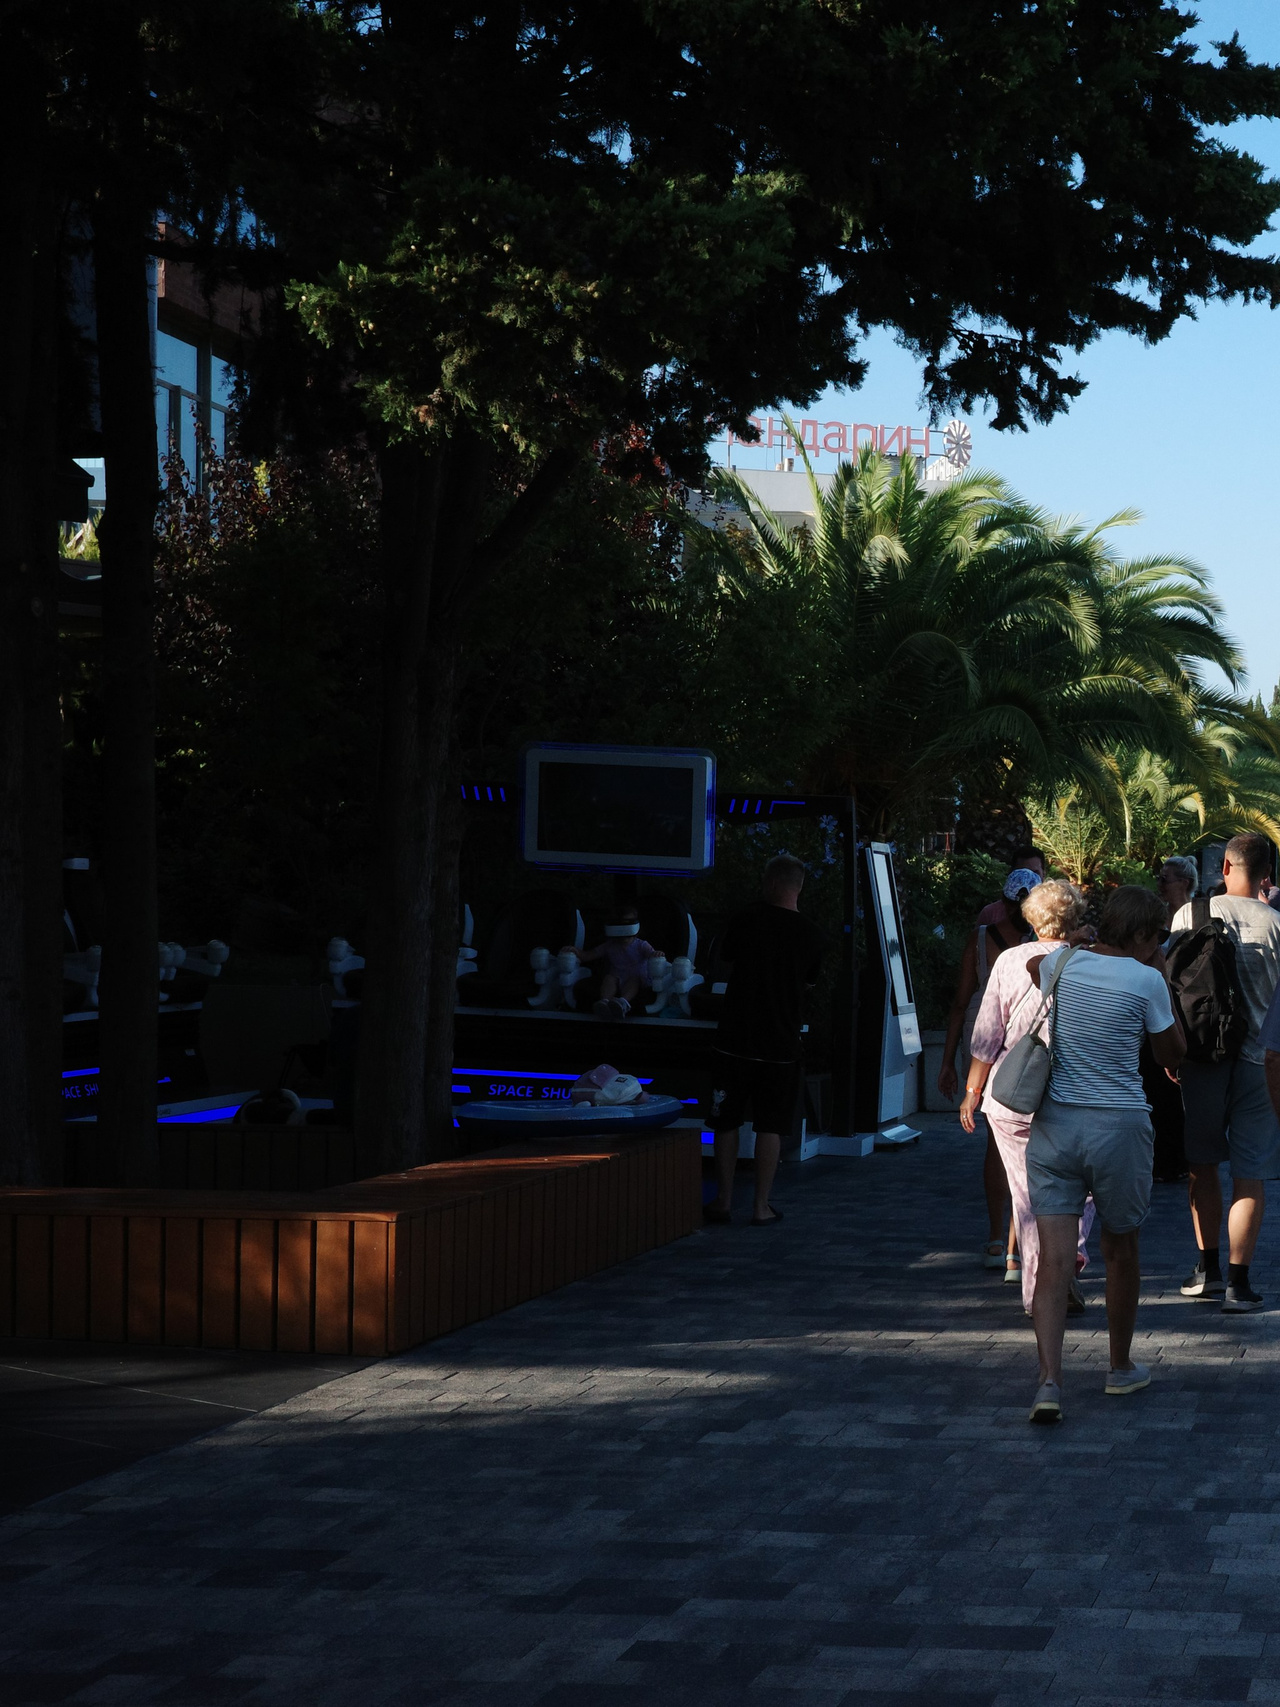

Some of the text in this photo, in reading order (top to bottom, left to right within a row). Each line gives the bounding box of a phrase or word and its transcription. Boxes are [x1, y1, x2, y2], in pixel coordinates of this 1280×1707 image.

[716, 414, 931, 466] андарин
[61, 1085, 82, 1100] ACE
[487, 1084, 572, 1100] SPACE SHU
